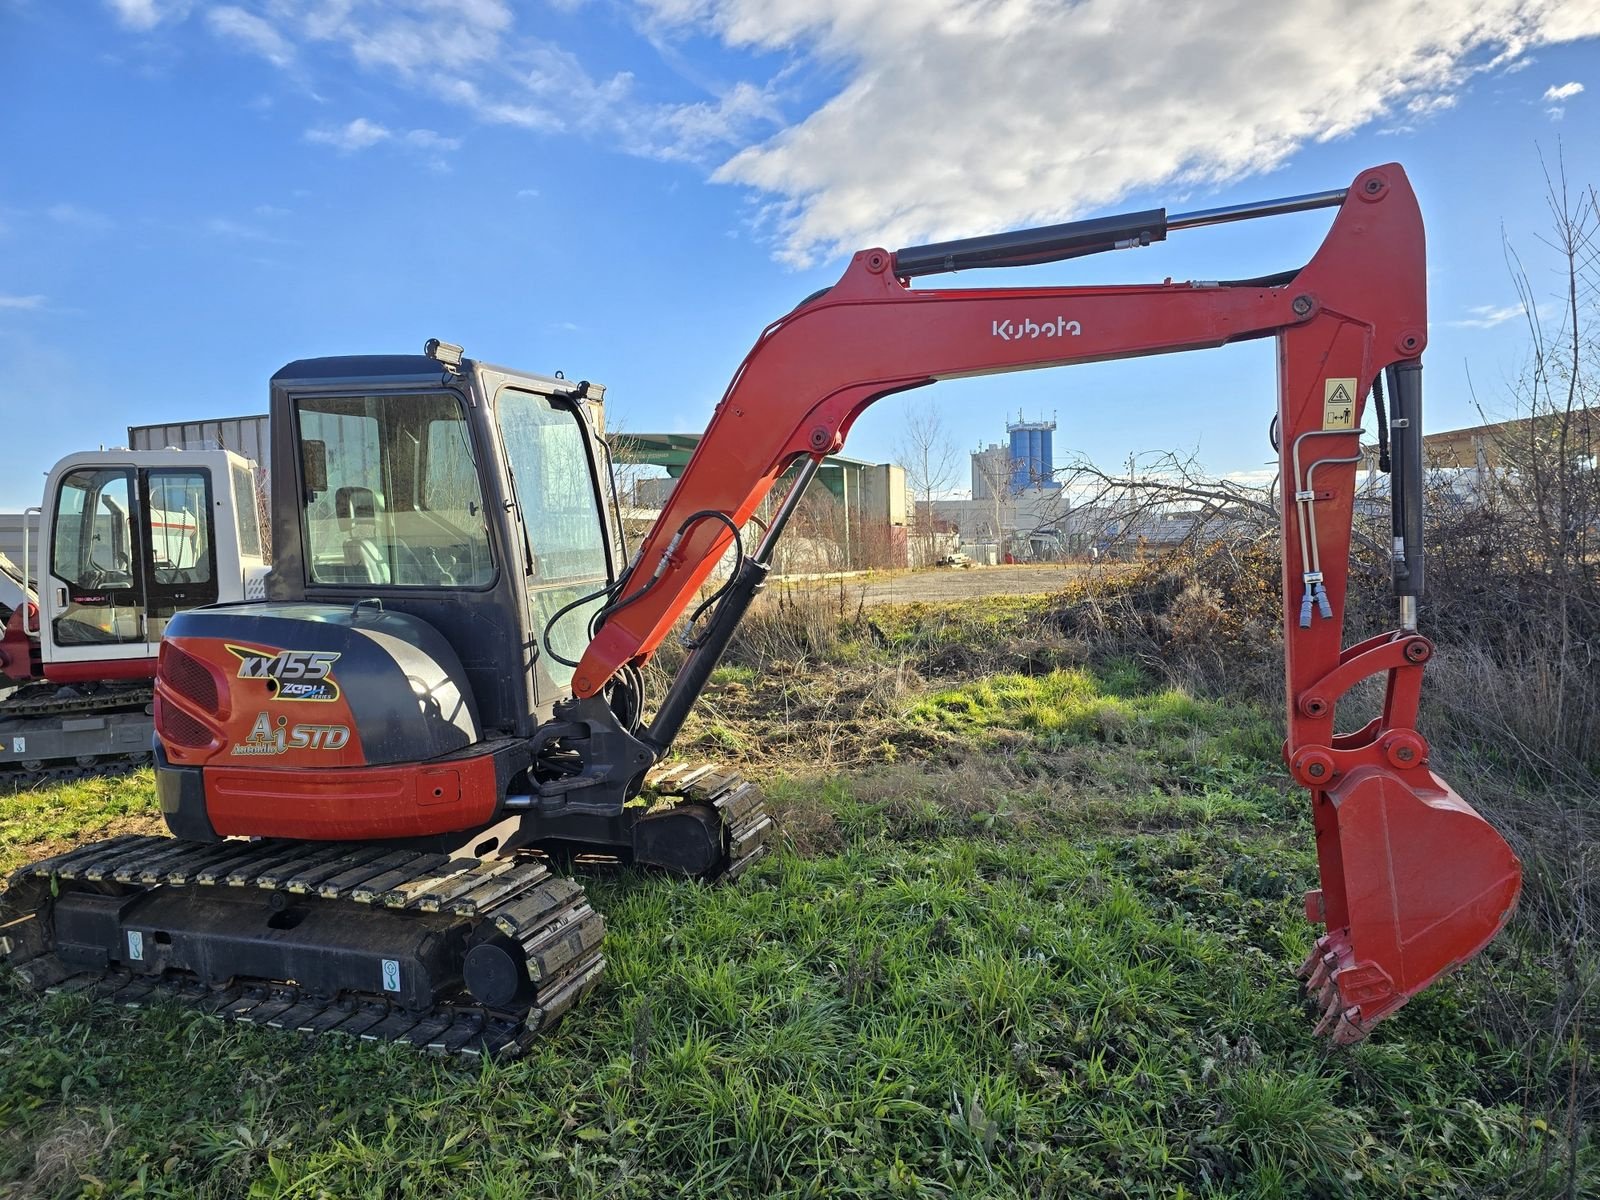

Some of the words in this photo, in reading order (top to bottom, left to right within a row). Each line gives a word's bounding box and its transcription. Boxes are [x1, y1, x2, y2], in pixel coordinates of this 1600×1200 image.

[992, 316, 1081, 340] Kubota
[239, 653, 338, 679] KX155
[288, 724, 350, 749] STD
